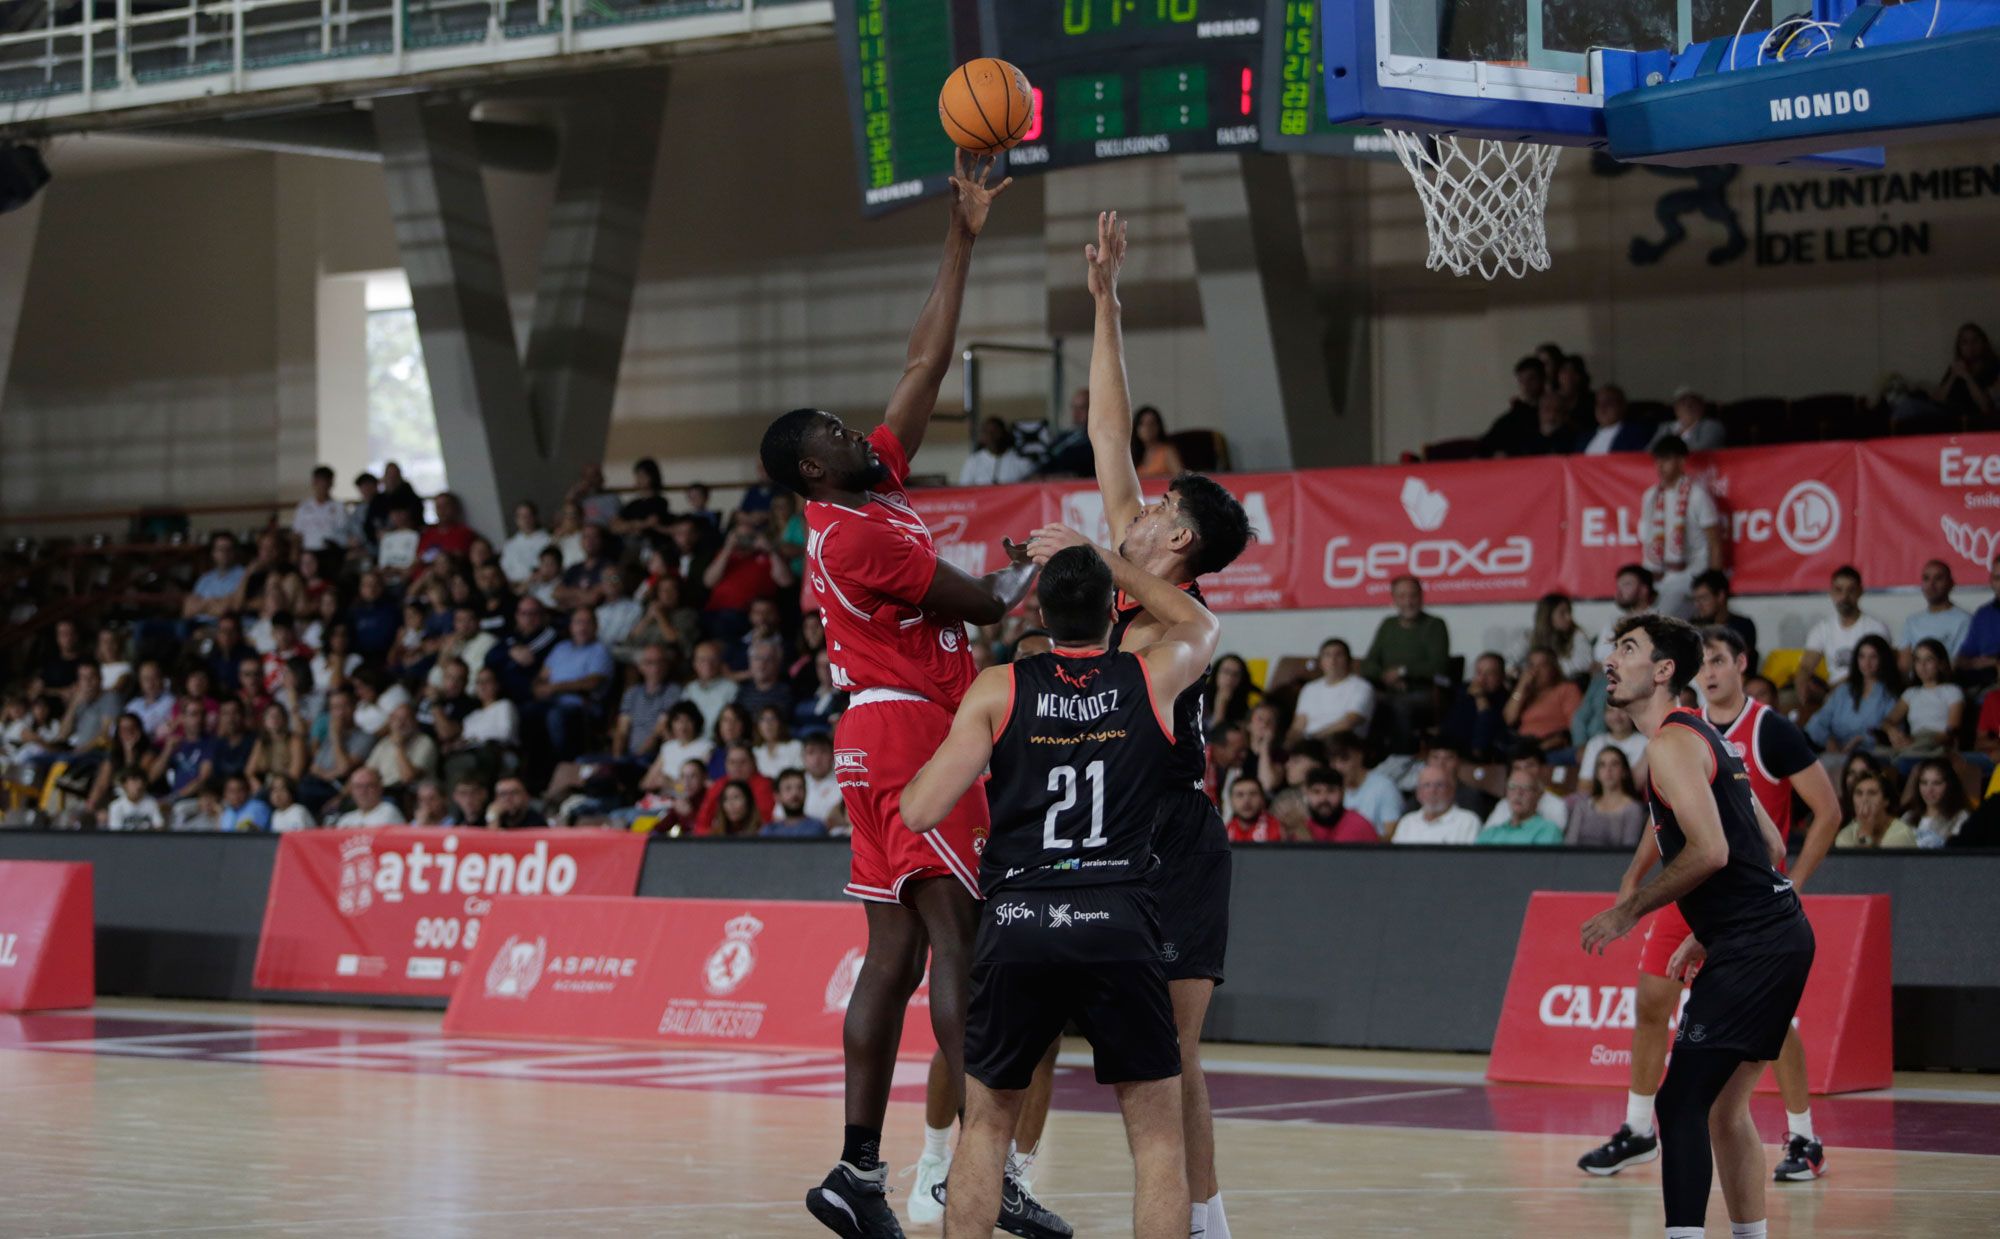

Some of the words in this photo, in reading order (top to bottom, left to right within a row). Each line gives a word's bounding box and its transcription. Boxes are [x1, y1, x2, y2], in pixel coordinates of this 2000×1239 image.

[1197, 18, 1260, 38] MONDO
[1284, 27, 1311, 54] 15
[861, 37, 885, 62] 11
[1283, 54, 1311, 81] 21
[1770, 88, 1871, 123] MONDO
[1095, 134, 1170, 159] EXCLUSIONES
[1216, 125, 1259, 146] FALTAS
[1009, 145, 1050, 166] FALTAS
[865, 179, 924, 206] MONDO
[1763, 229, 1816, 266] DE
[1823, 212, 1930, 263] LEÓN
[1042, 760, 1108, 850] 21
[375, 834, 578, 902] atiendo
[1073, 910, 1110, 922] Deporte
[413, 915, 462, 950] 900
[657, 1006, 765, 1040] BALONCESTO
